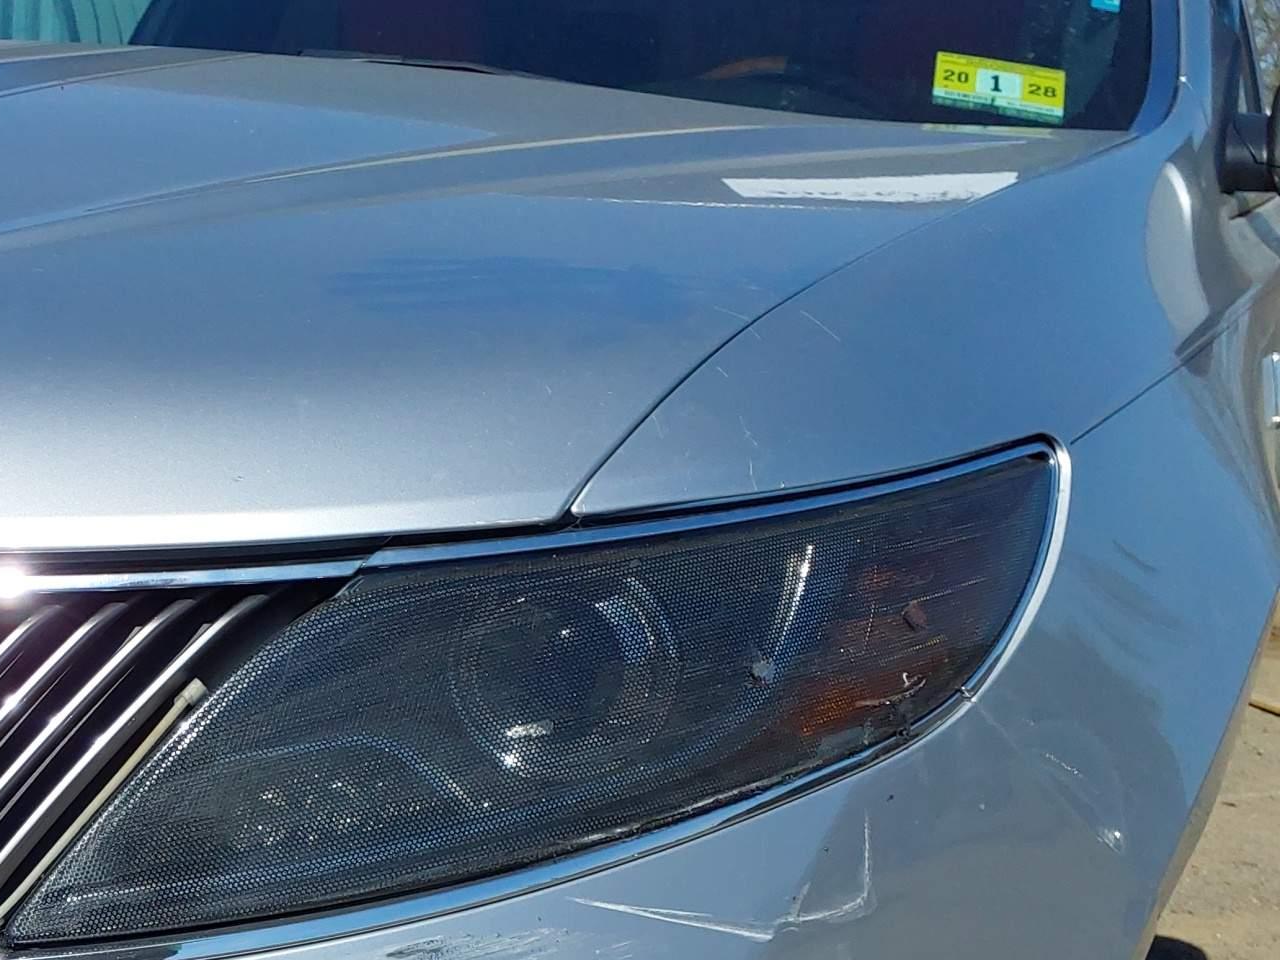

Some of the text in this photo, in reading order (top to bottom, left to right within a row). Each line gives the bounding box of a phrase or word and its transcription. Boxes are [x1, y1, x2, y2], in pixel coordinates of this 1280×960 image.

[943, 69, 1057, 98] 20 1 28
